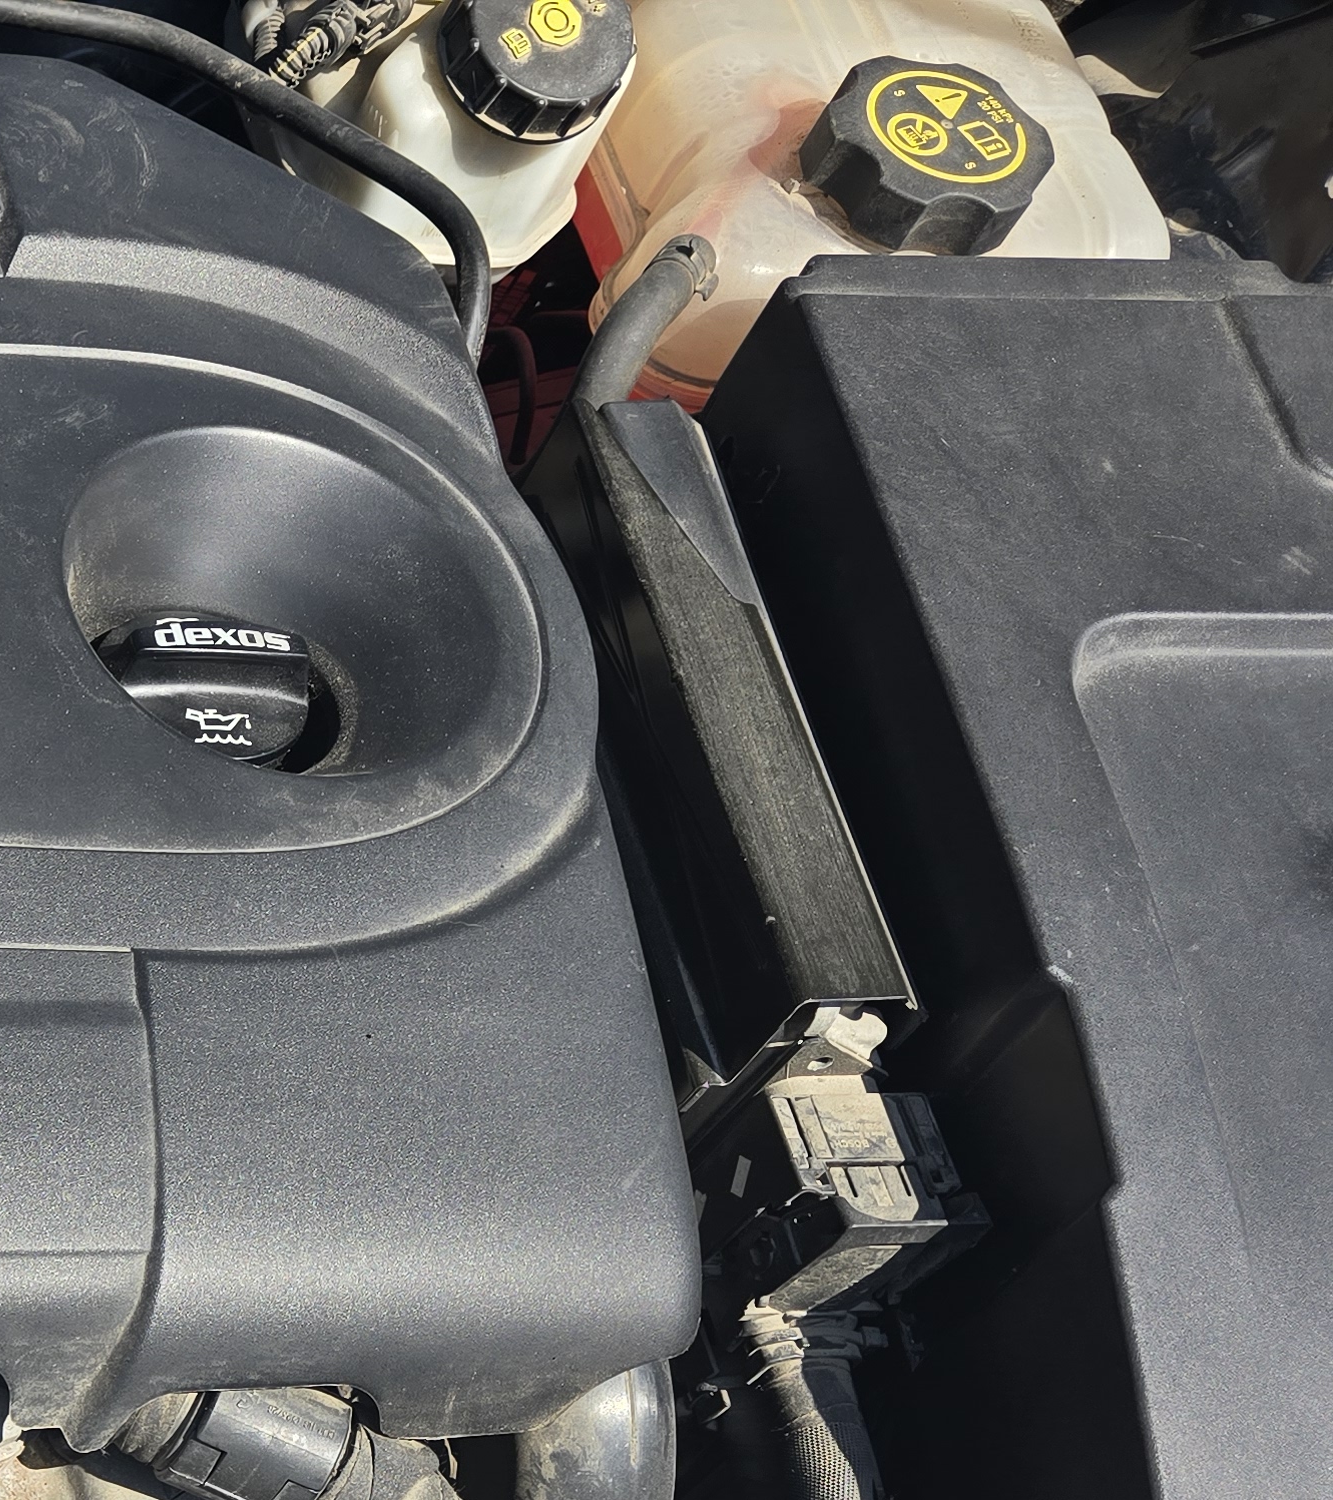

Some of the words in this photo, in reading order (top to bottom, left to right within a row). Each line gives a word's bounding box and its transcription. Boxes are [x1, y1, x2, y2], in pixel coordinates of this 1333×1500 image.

[976, 100, 991, 112] 20
[986, 110, 1004, 124] PSI
[985, 95, 1002, 109] 140
[154, 622, 291, 652] dexos
